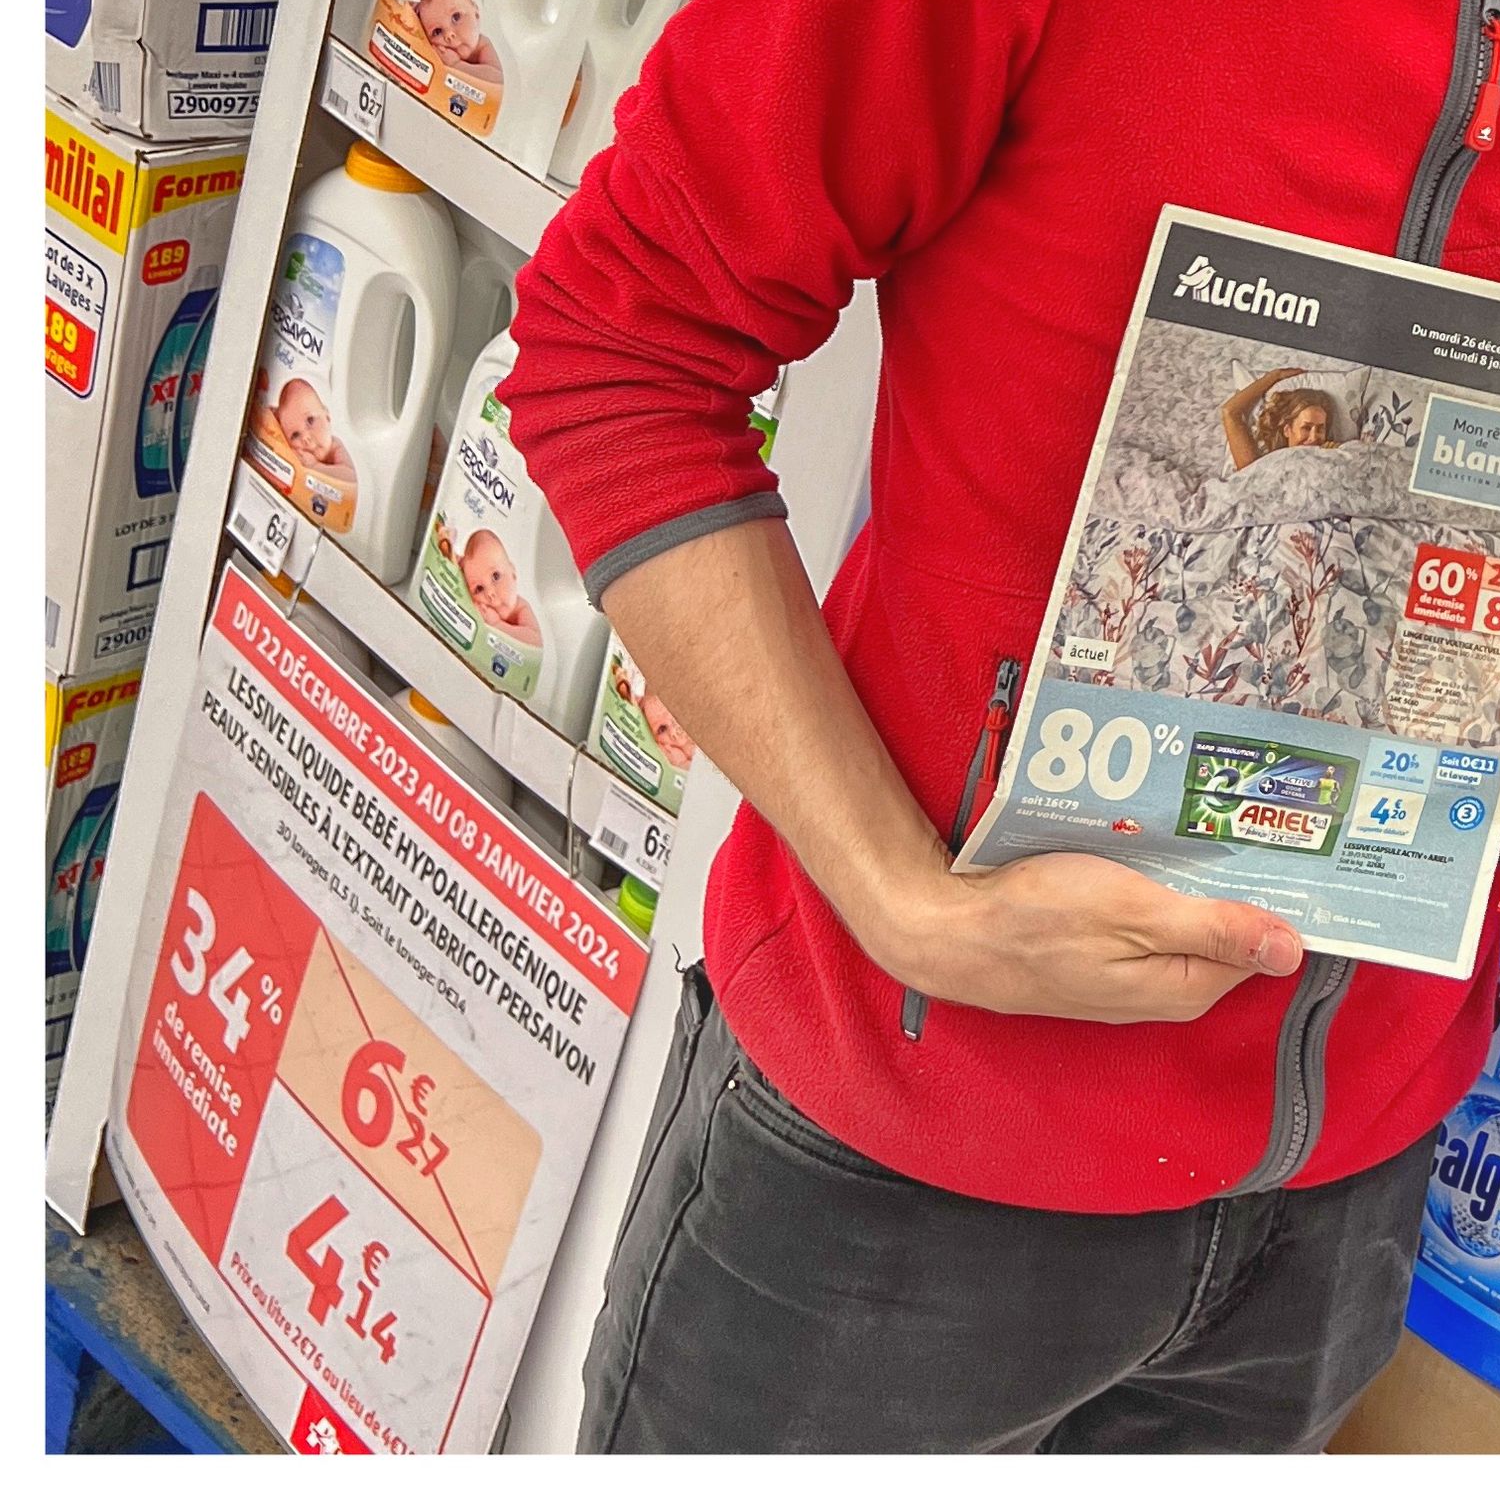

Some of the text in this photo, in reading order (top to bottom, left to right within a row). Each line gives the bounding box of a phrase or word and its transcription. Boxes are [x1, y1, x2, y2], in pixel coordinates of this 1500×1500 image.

[1173, 256, 1320, 327] Auchan
[1412, 323, 1427, 338] Du
[1428, 326, 1461, 347] mardi
[1463, 335, 1477, 350] 26
[1433, 346, 1448, 358] au
[1449, 345, 1478, 364] lundi
[1452, 418, 1483, 438] Mon
[459, 439, 516, 510] PERSAVON
[231, 602, 621, 980] DU 22 DÉCEMBRE 2023 AU 08 JANVIER 2024
[1021, 794, 1080, 810] soit 16€79
[1037, 810, 1067, 821] votre
[1067, 814, 1109, 829] compte
[1238, 804, 1314, 836] ARIEL
[227, 667, 588, 1026] LESSIVE LIQUIDE BÉBÉ HYPOALLERGÉNIQUE
[201, 695, 247, 751] PEAUX
[245, 740, 323, 826] SENSIBLES
[332, 824, 412, 914] L'EXTRAIT
[409, 898, 503, 996] D'ABRICOT
[498, 987, 597, 1086] PERSAVON
[361, 905, 384, 936] Soit
[151, 1022, 239, 1158] immédiate
[163, 1002, 243, 1117] de remise
[230, 1251, 252, 1288] Prix
[266, 1295, 292, 1336] litre
[291, 1326, 324, 1371] 2€76
[322, 1366, 339, 1390] au
[339, 1379, 364, 1419] lieu
[364, 1411, 381, 1437] de
